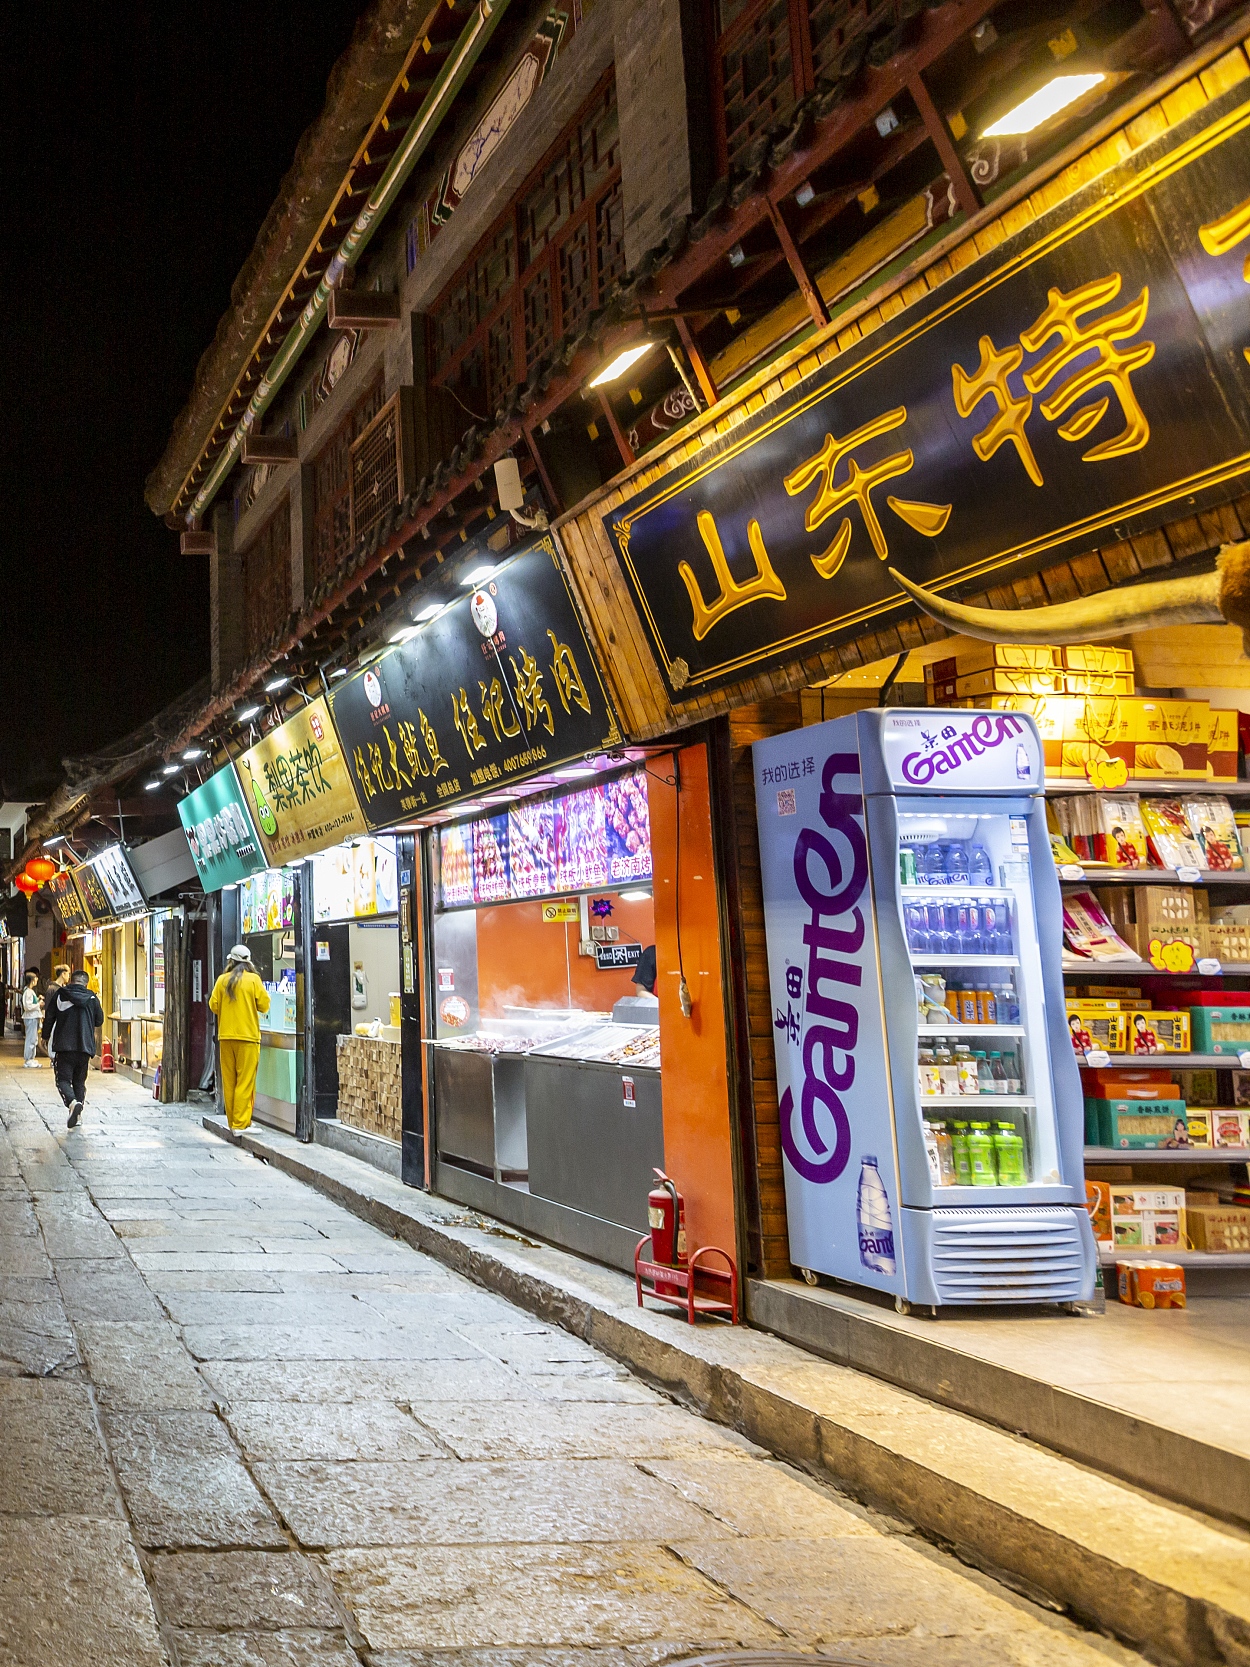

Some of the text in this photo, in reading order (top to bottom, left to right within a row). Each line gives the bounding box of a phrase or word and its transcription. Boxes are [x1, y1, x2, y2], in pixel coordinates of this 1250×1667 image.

[678, 198, 1250, 641] 山东特
[762, 756, 816, 785] 我的选择
[902, 715, 1024, 785] Ganten
[627, 950, 640, 959] EXIT
[780, 753, 869, 1184] Ganten
